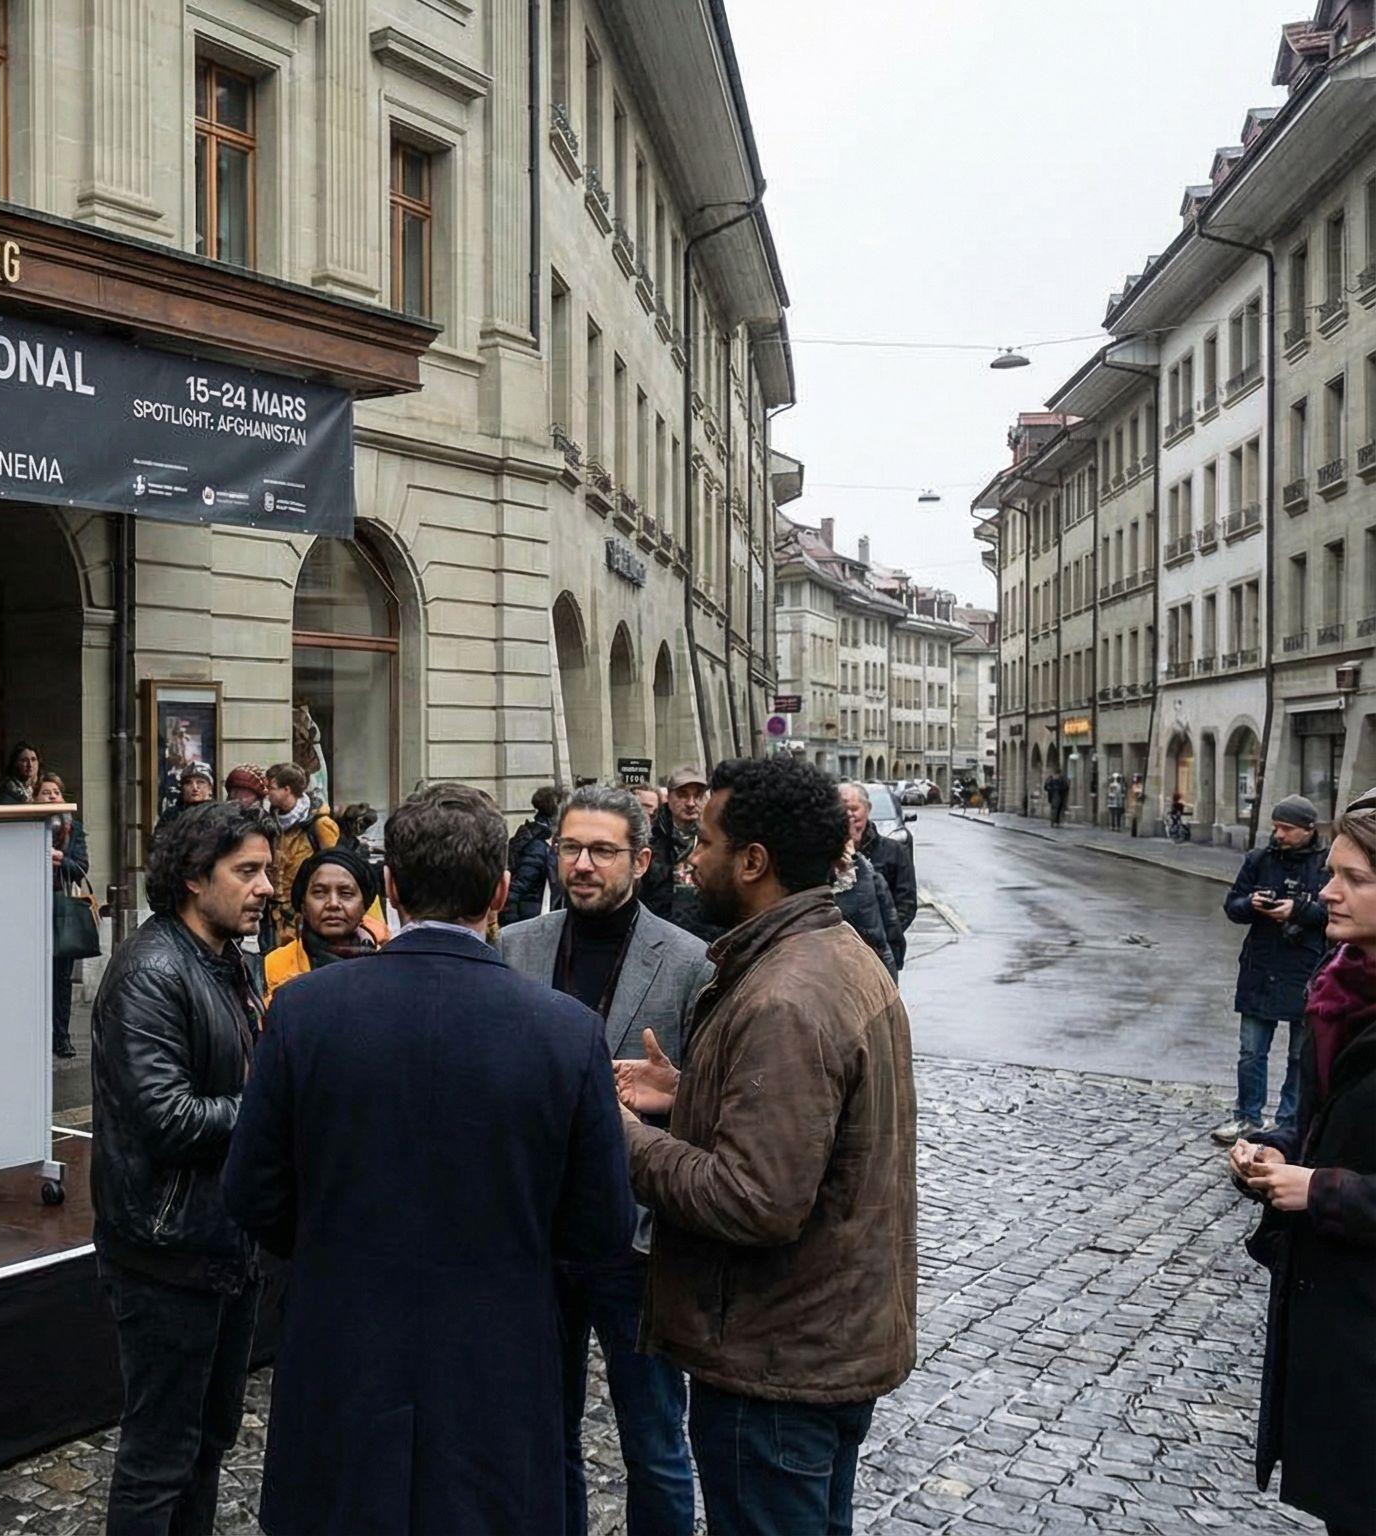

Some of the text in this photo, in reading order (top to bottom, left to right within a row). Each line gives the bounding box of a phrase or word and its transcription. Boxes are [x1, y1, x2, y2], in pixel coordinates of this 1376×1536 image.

[132, 398, 308, 447] SPOTLIGHT: AFGHANISTAN
[252, 388, 308, 422] MARS
